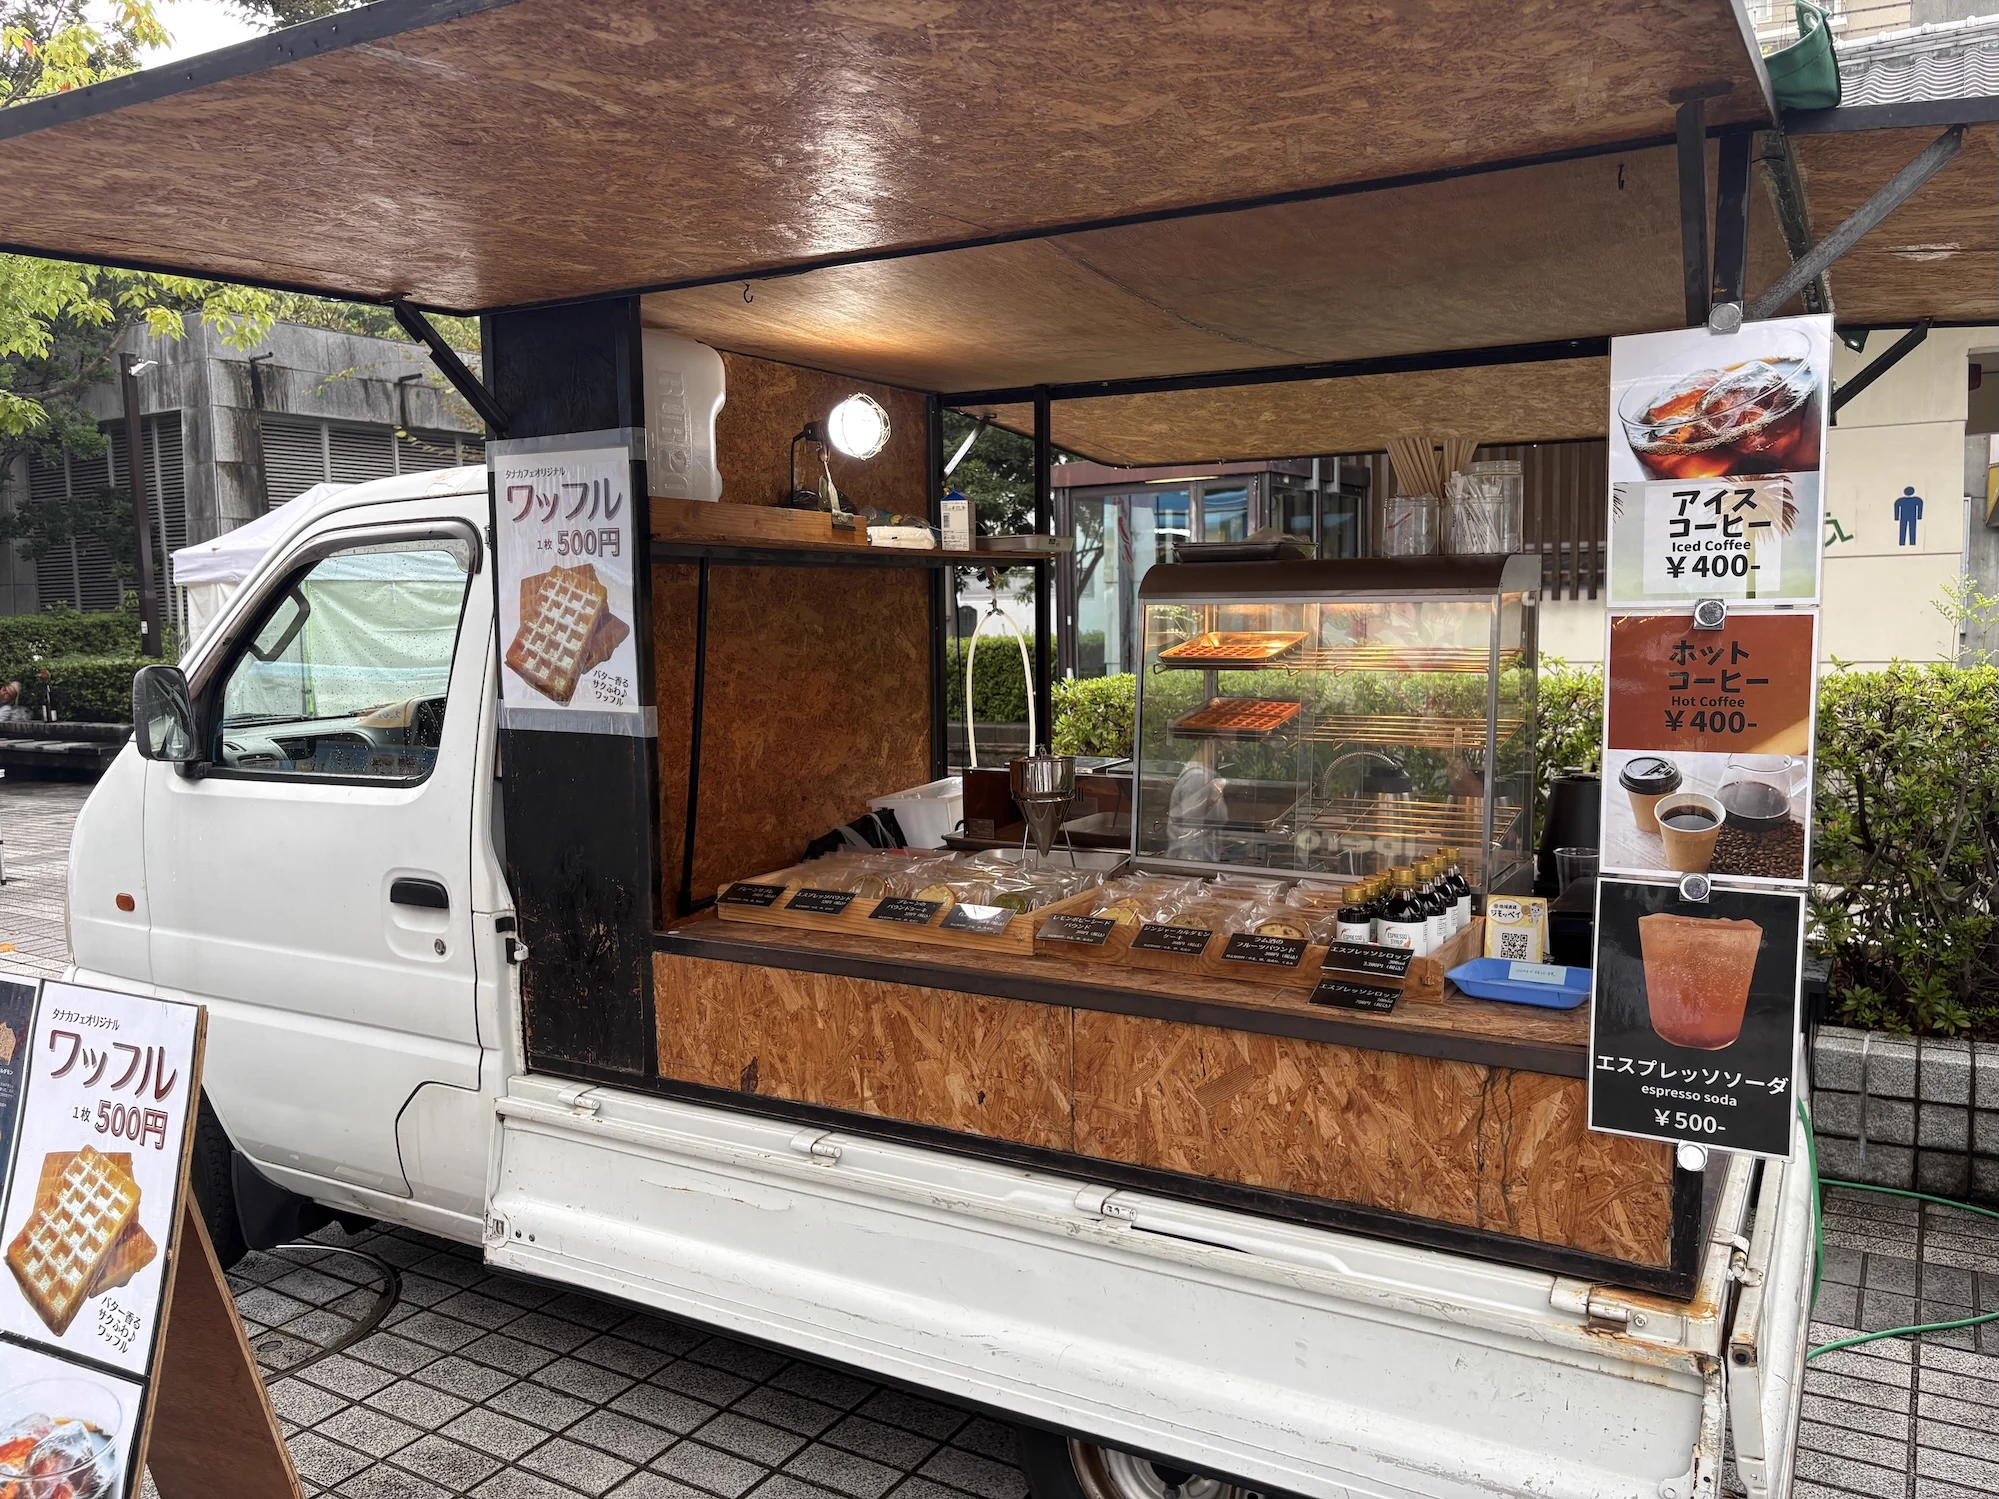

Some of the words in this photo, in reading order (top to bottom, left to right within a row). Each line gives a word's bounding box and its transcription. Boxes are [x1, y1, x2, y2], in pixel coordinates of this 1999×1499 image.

[505, 467, 565, 479] タナカフェオリジナル
[506, 477, 623, 523] ワッフル
[1672, 488, 1758, 517] アイス
[1669, 514, 1771, 538] コーヒー
[537, 539, 553, 550] 1枚
[557, 528, 620, 558] 500円
[1672, 540, 1702, 552] Iced
[1705, 539, 1751, 551] Coffee
[1669, 640, 1750, 666] ホット
[594, 670, 629, 688] バター香る
[1668, 669, 1769, 693] コーヒー
[595, 689, 624, 706] ワッフル
[1672, 696, 1696, 708] Hot
[1699, 696, 1745, 708] Coffee
[52, 1008, 120, 1031] タナカフェオリジナル
[48, 1029, 178, 1103] ワッフル
[1596, 1054, 1789, 1096] エスプレッソソーダ
[1641, 1084, 1701, 1101] espresso
[1704, 1092, 1738, 1107] soda
[72, 1105, 90, 1123] 1枚
[94, 1099, 168, 1150] 500円
[101, 1295, 142, 1330] バター香る
[97, 1323, 129, 1354] ワッフル
